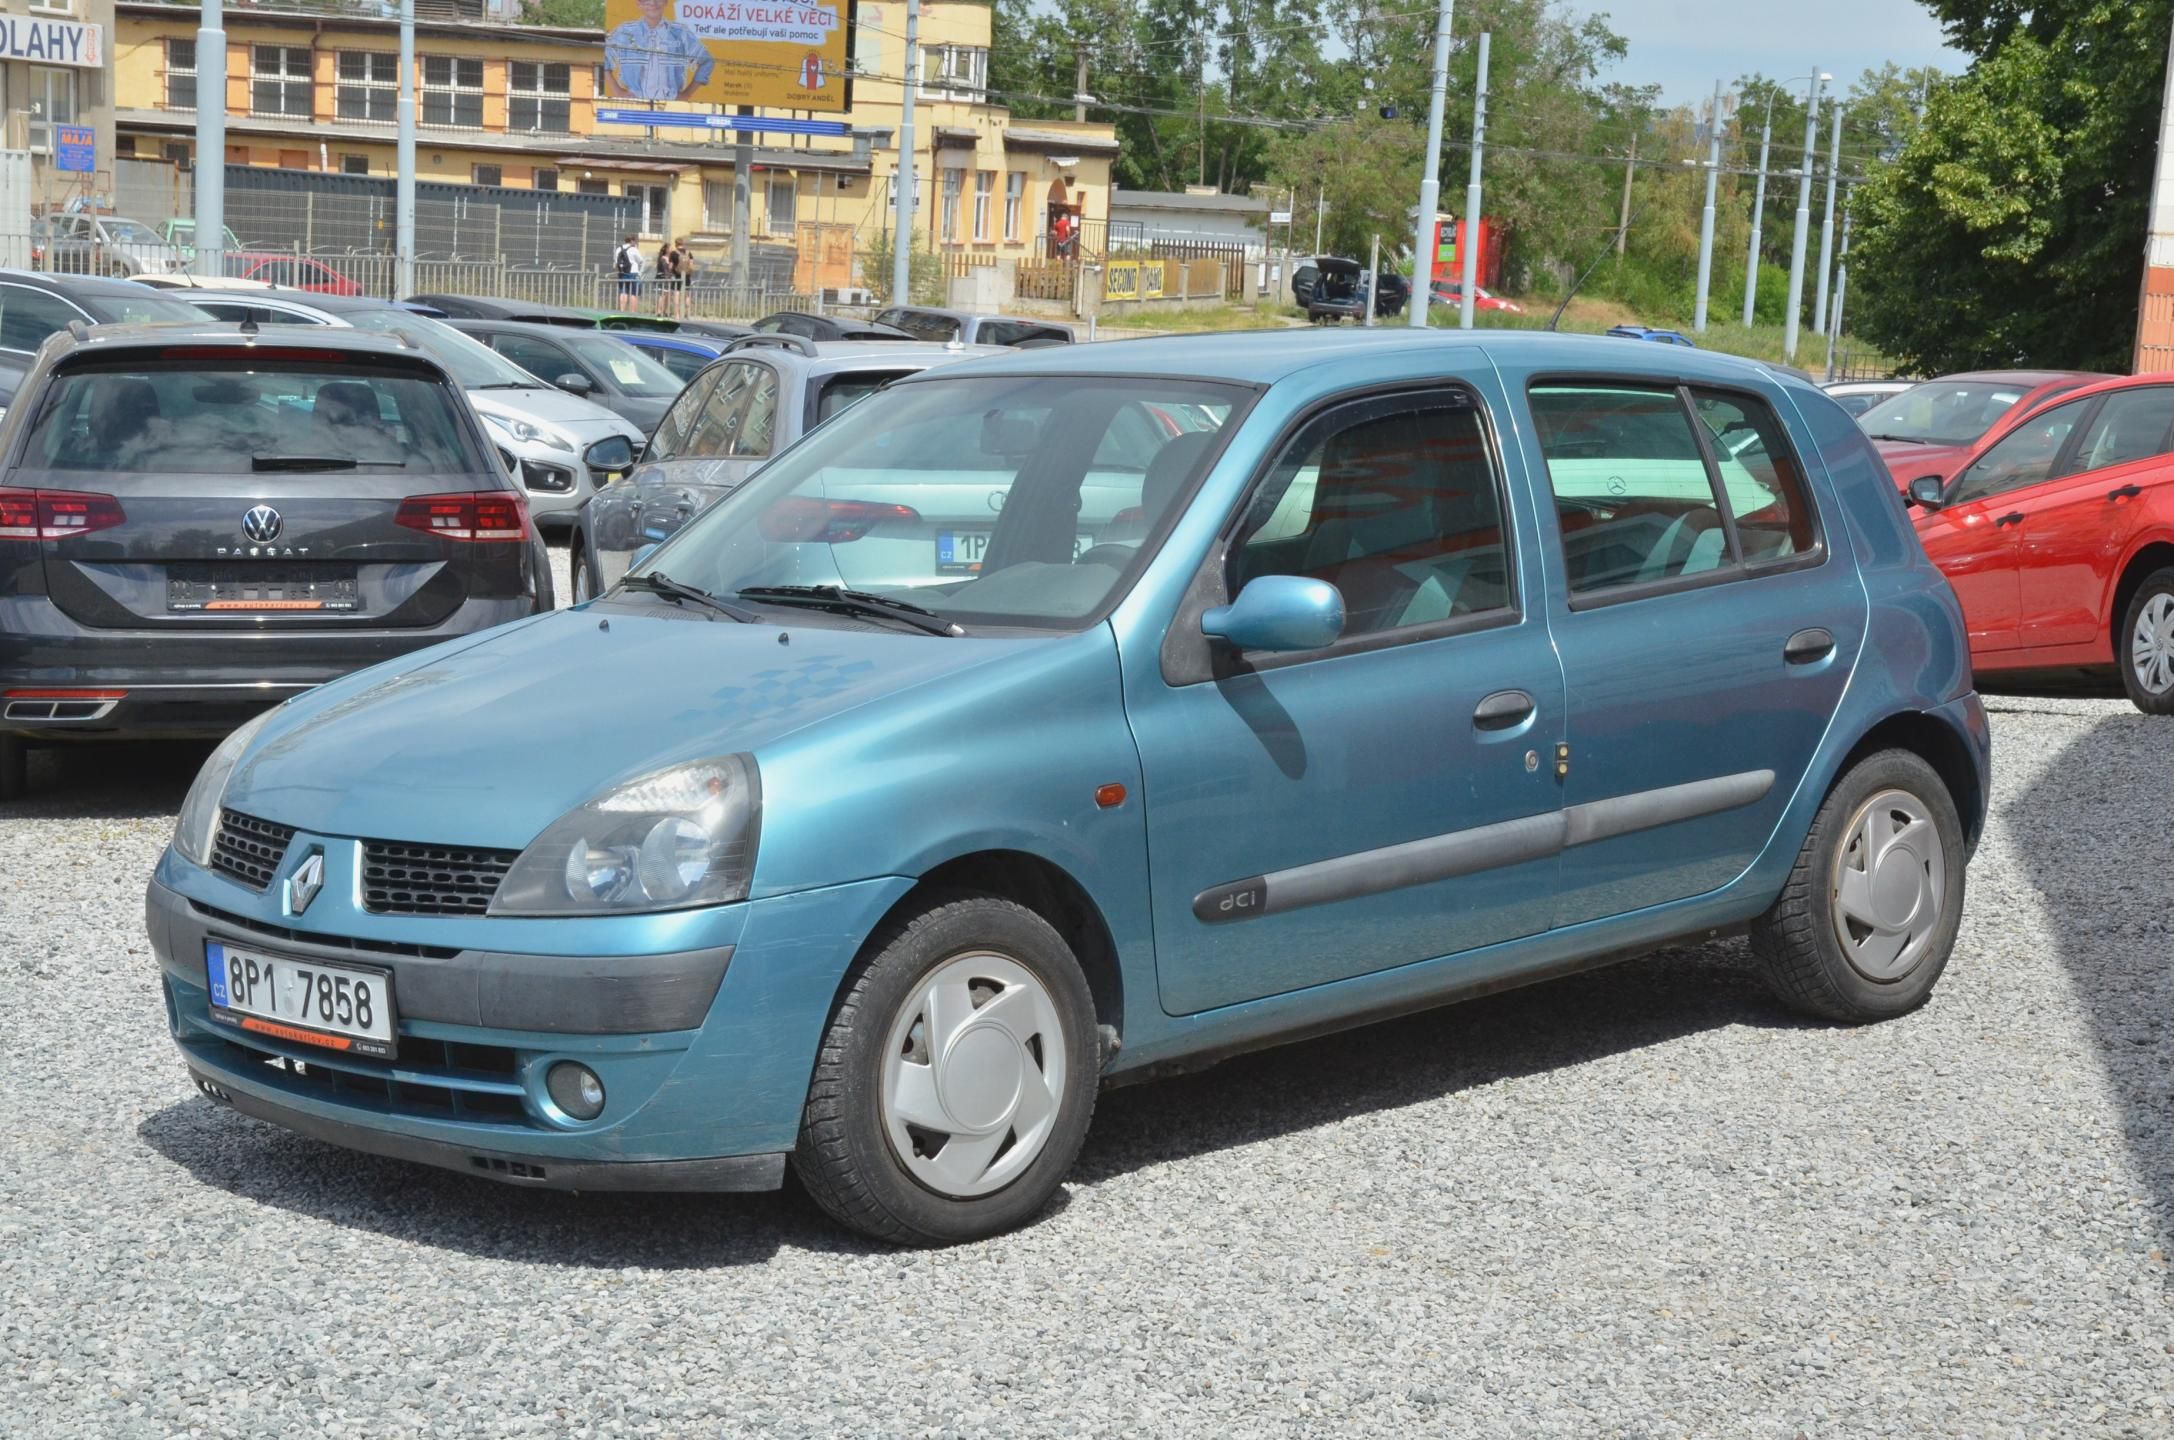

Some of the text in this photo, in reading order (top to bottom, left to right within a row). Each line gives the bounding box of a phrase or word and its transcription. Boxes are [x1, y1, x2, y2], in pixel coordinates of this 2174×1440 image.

[682, 4, 832, 26] DOKÁŽÍ VELKÉ VĚCI
[694, 24, 819, 40] Teď ale potřebují vaši pomoc
[1108, 267, 1137, 292] SECOND
[217, 547, 309, 556] PASSAT
[940, 551, 952, 559] CZ
[213, 983, 226, 999] CZ
[229, 956, 373, 1029] 8P1 7858
